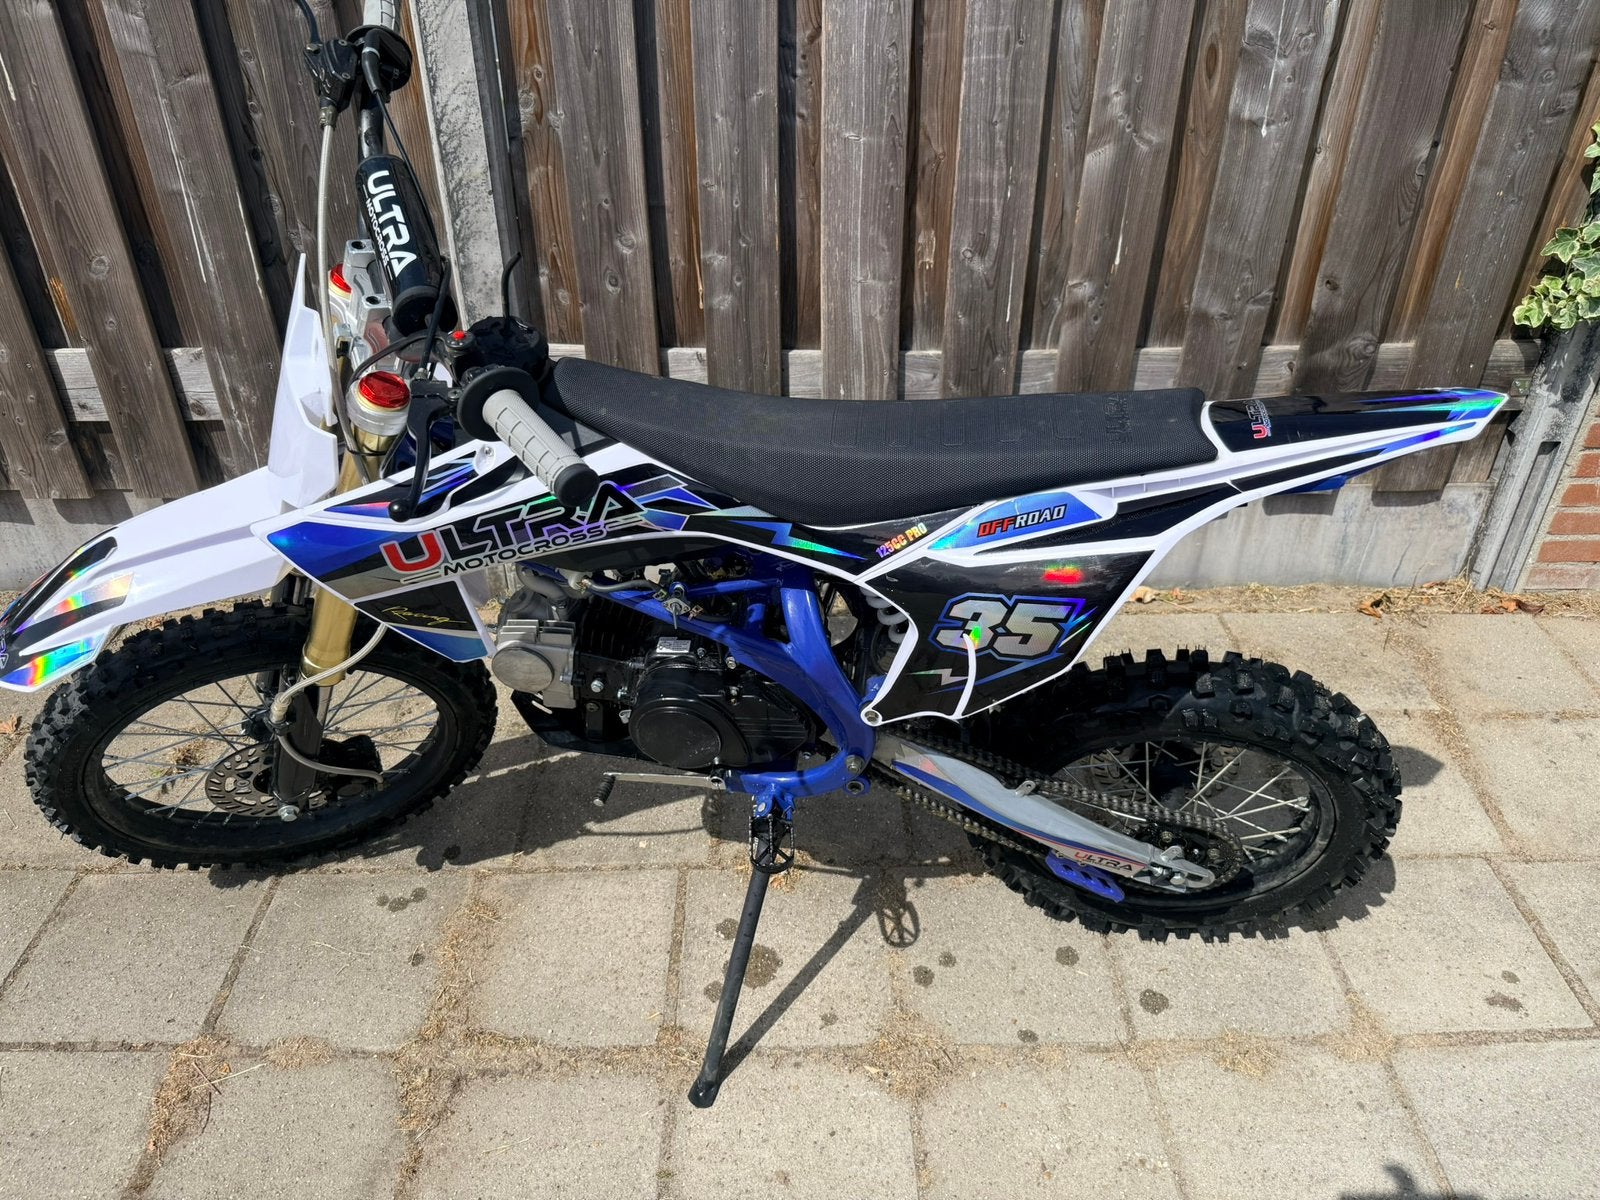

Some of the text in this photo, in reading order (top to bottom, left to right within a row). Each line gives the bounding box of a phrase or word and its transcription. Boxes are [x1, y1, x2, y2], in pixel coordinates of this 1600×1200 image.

[365, 197, 390, 267] MOTOCROSS
[367, 169, 417, 278] ULTRA
[380, 480, 648, 573] ULTRA
[875, 522, 928, 558] 125CC PRO
[977, 504, 1067, 537] OFFROAD
[443, 527, 605, 576] MOTOCROSS
[930, 596, 1078, 660] 35
[1074, 851, 1132, 871] ULTRA
